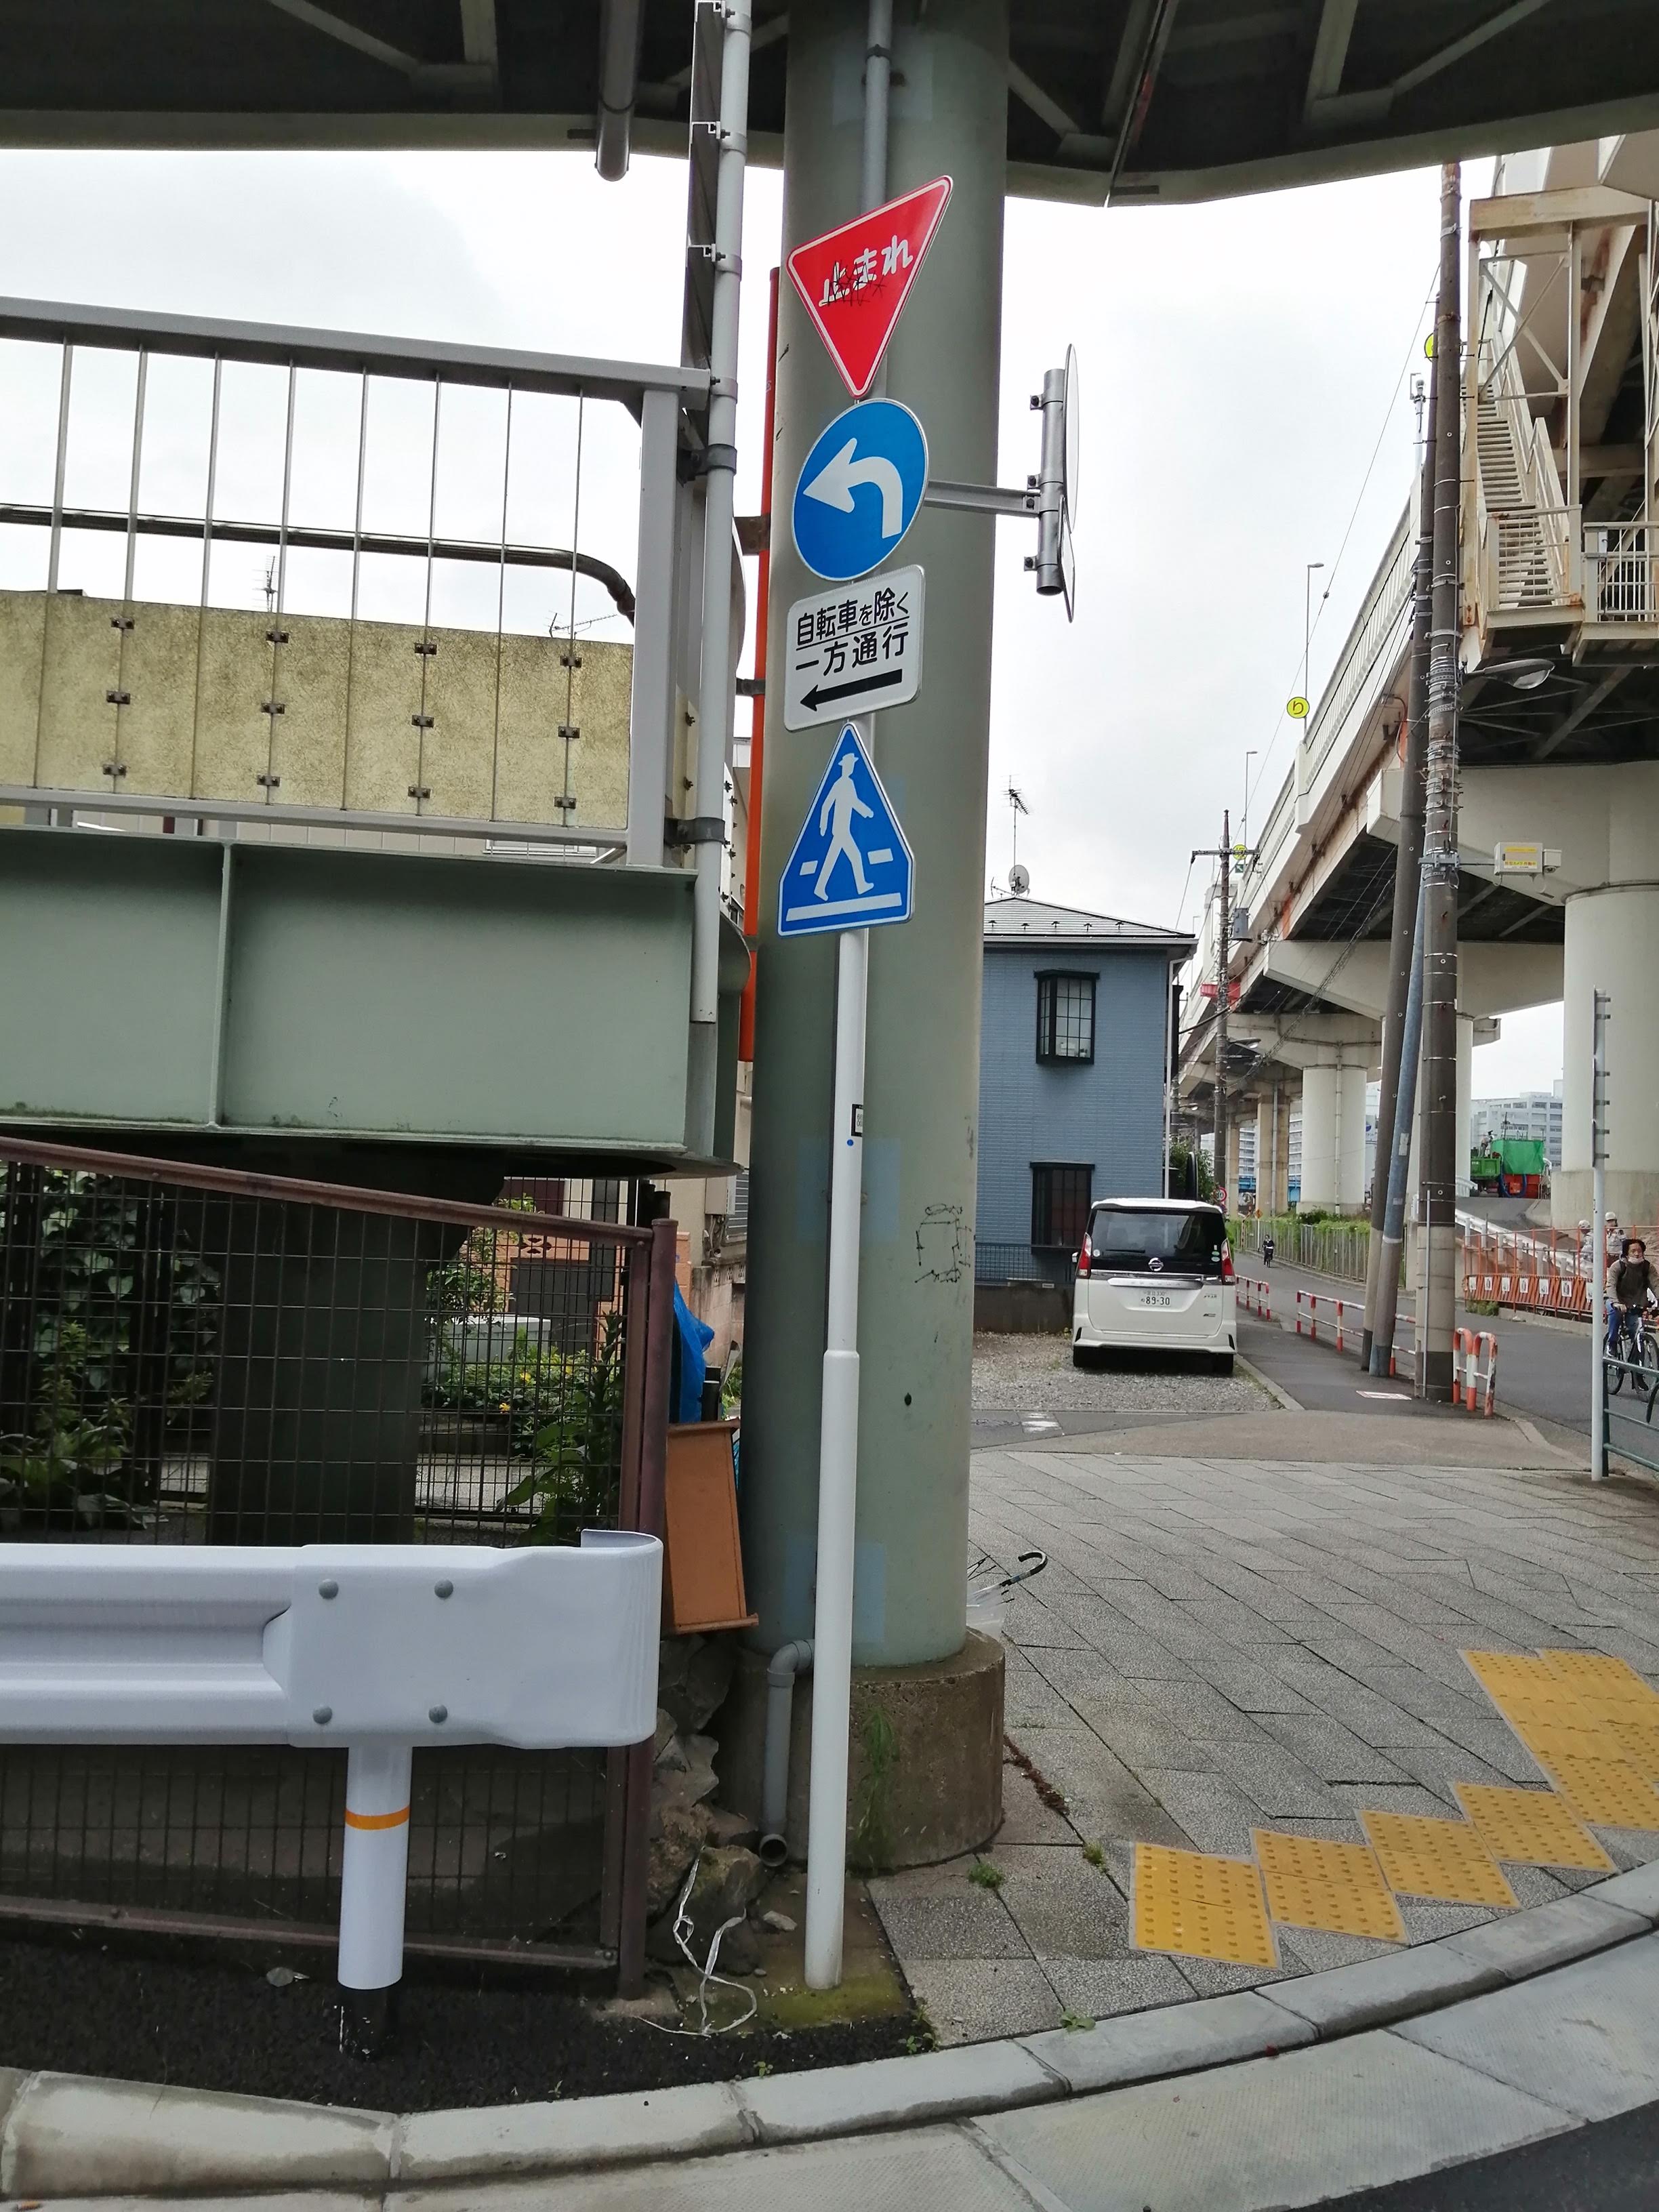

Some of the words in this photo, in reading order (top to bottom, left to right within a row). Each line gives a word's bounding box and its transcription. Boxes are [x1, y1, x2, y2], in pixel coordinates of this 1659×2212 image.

[819, 234, 914, 307] 止まれ
[797, 587, 909, 646] 自転車を除く
[796, 621, 909, 676] 一方通行
[1292, 701, 1304, 714] り
